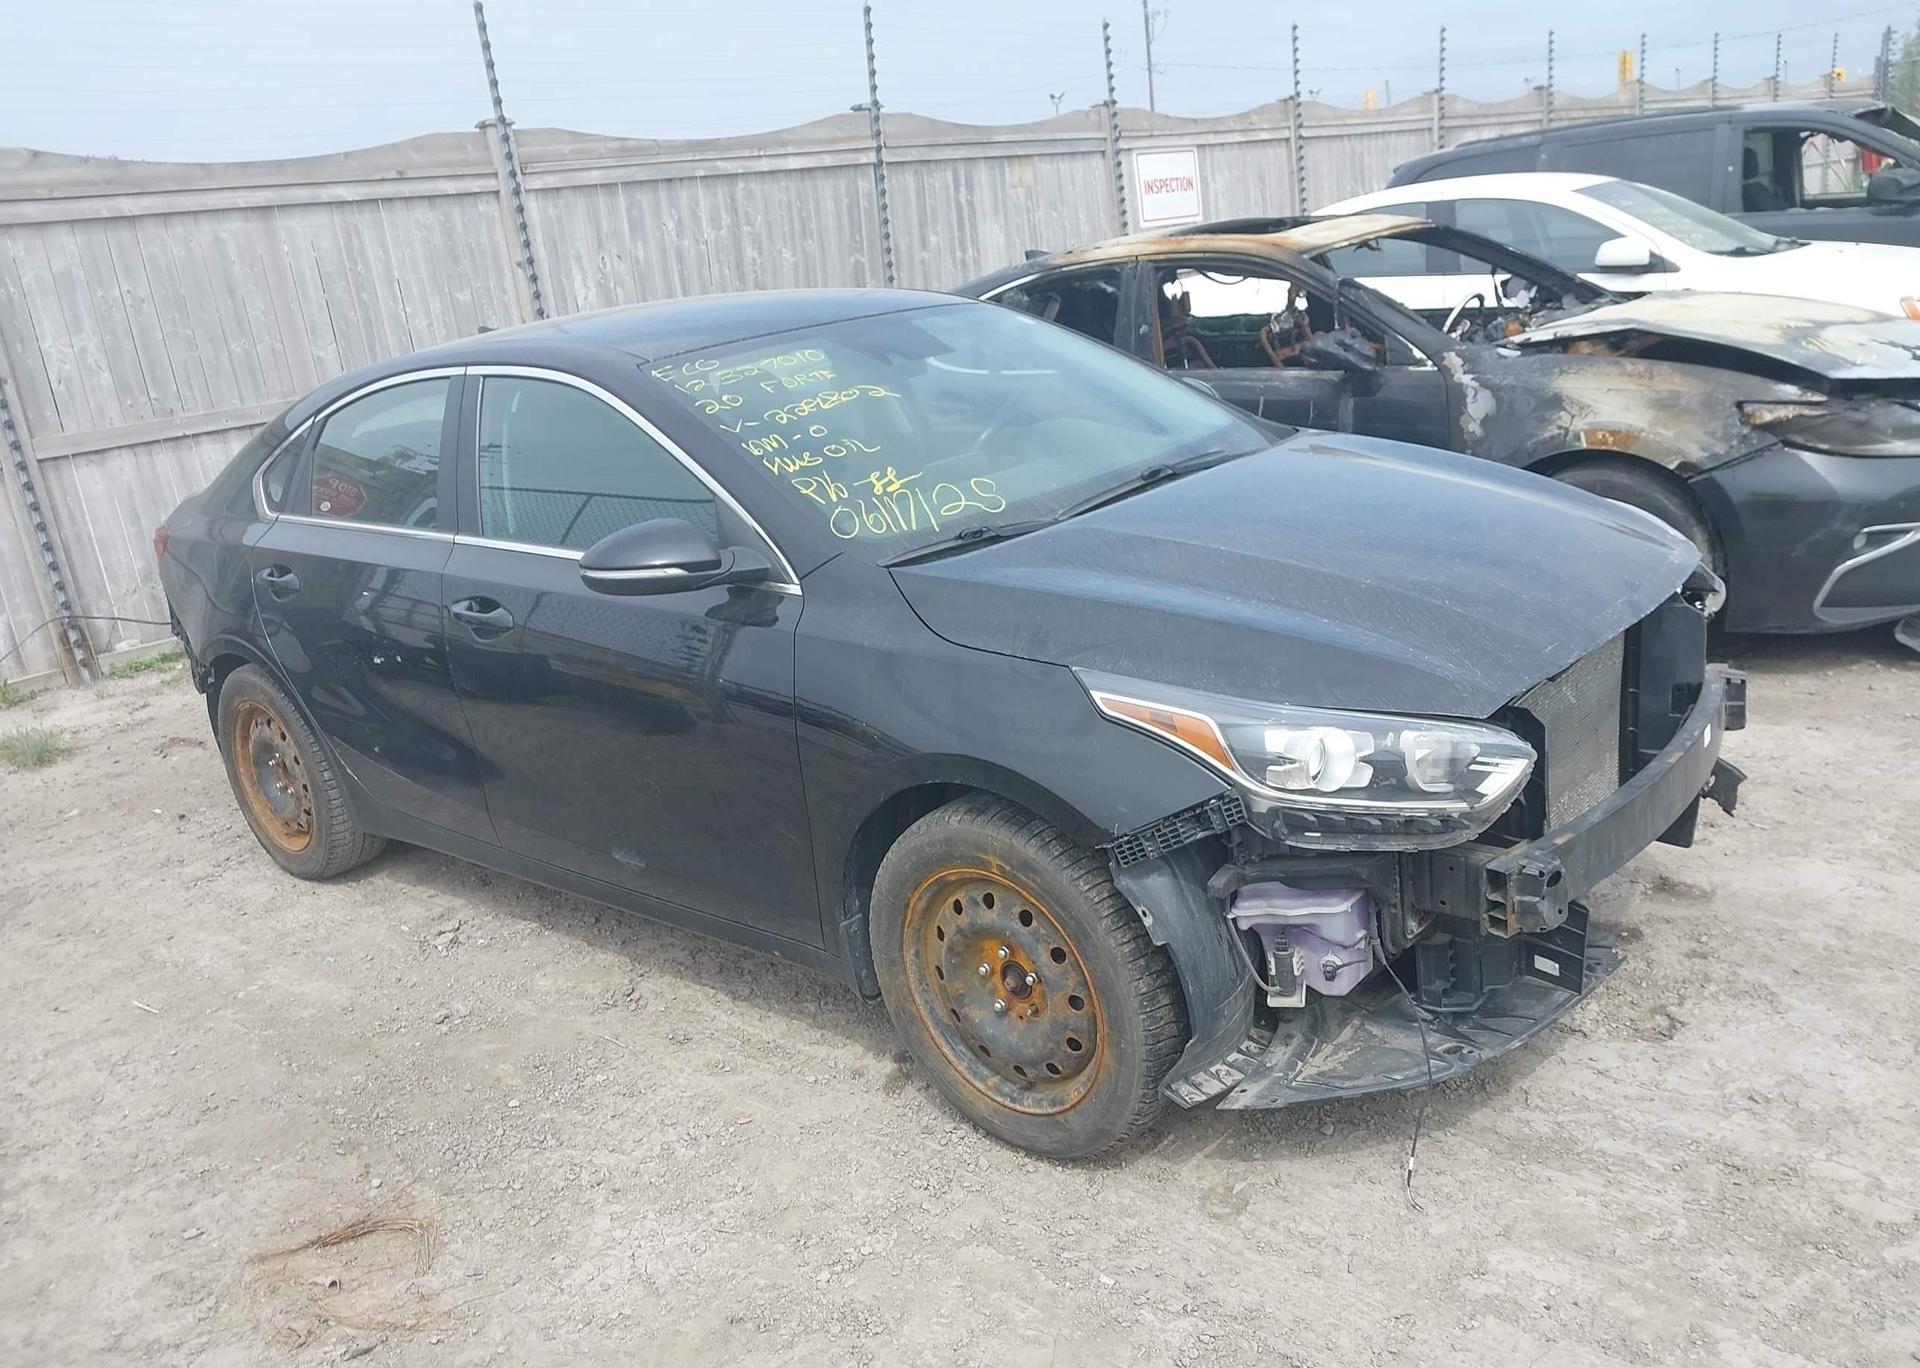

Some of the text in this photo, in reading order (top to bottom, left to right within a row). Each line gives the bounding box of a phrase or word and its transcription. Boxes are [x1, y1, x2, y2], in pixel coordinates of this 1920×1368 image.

[1143, 176, 1194, 195] INSPECTION
[694, 369, 836, 414] 20 FORTE
